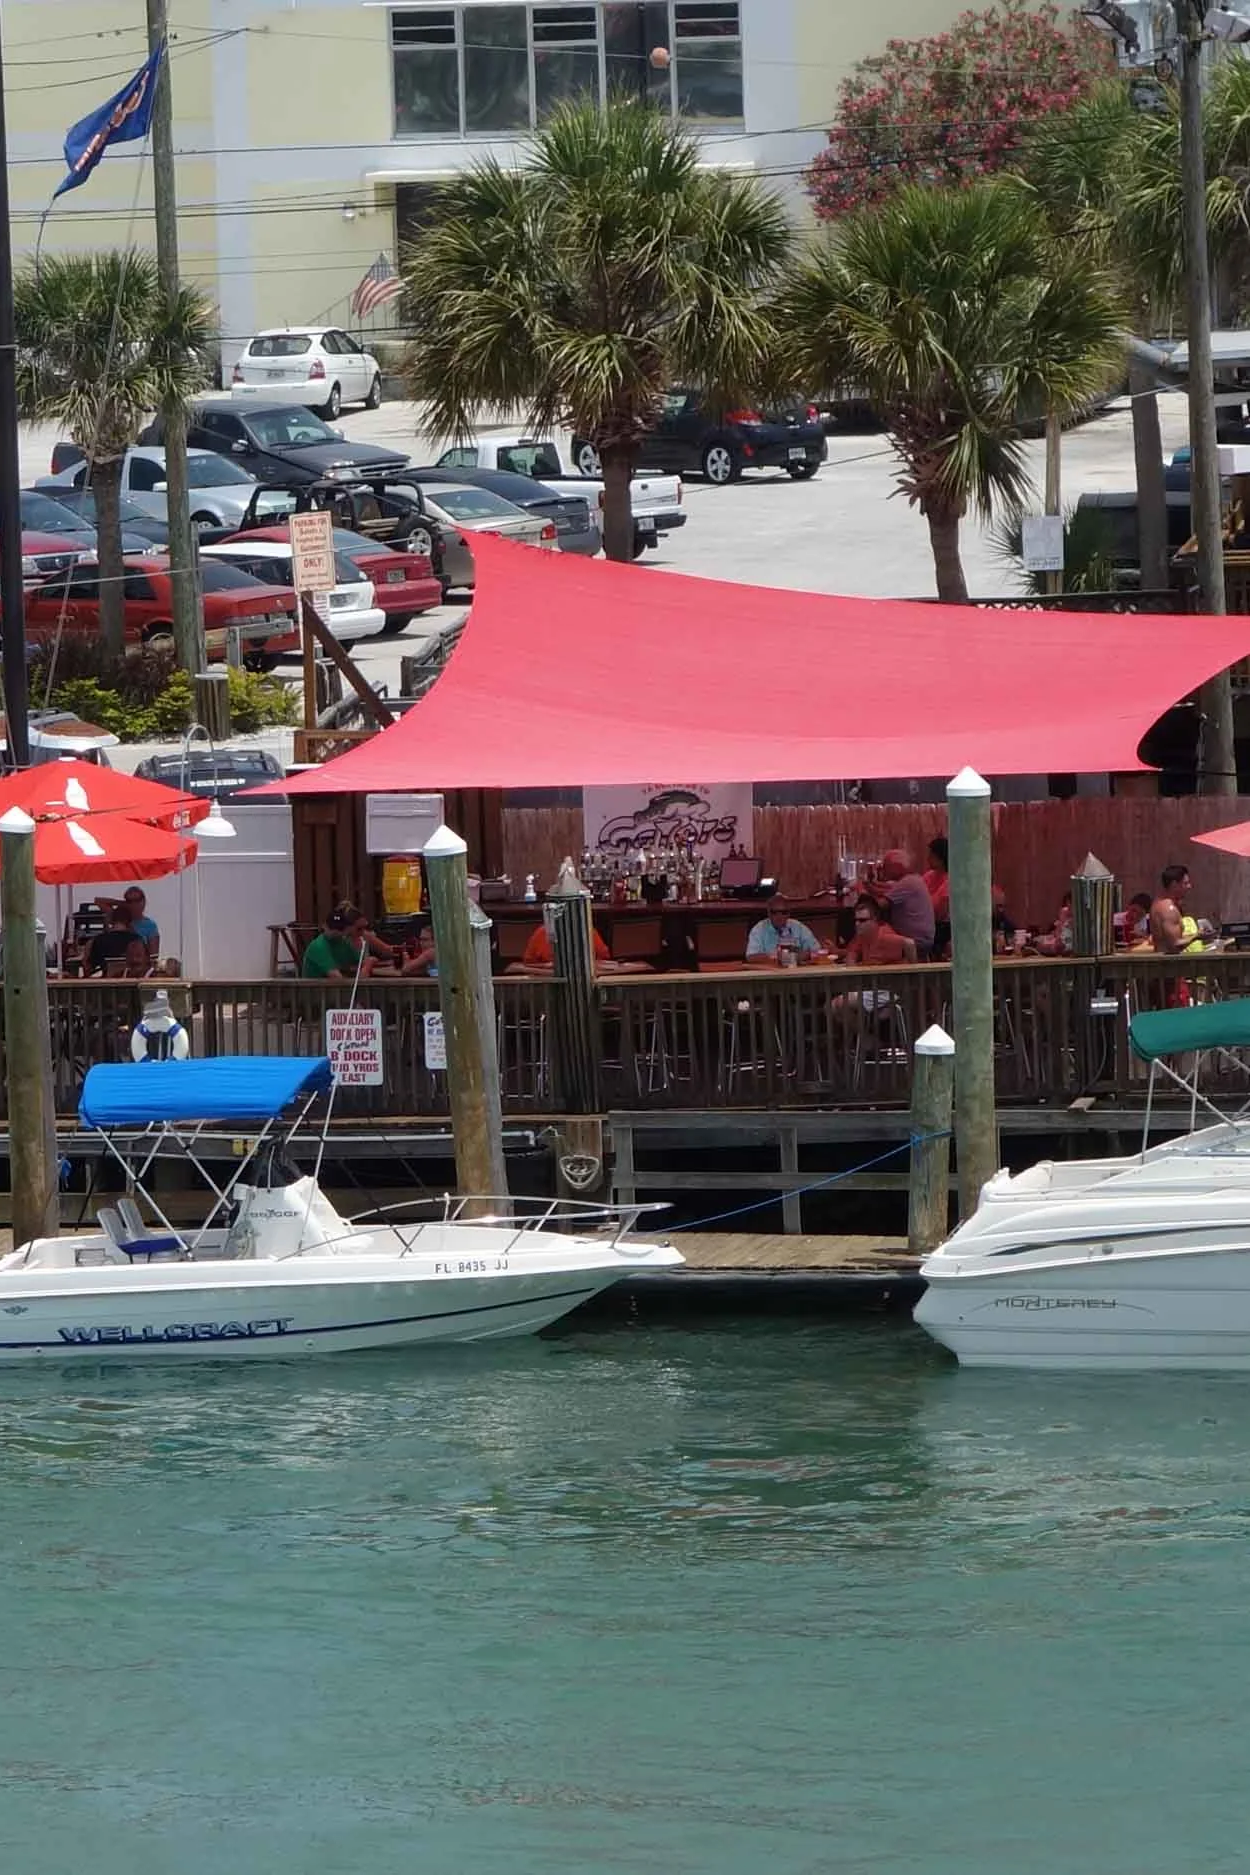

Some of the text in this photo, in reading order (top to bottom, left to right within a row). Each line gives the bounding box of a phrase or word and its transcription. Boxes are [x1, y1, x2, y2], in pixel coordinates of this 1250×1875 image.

[344, 1051, 377, 1061] DOCK
[342, 1073, 366, 1082] EAST
[435, 1263, 452, 1274] FL
[494, 1259, 508, 1270] JJ
[57, 1317, 295, 1343] WELLCRAFT
